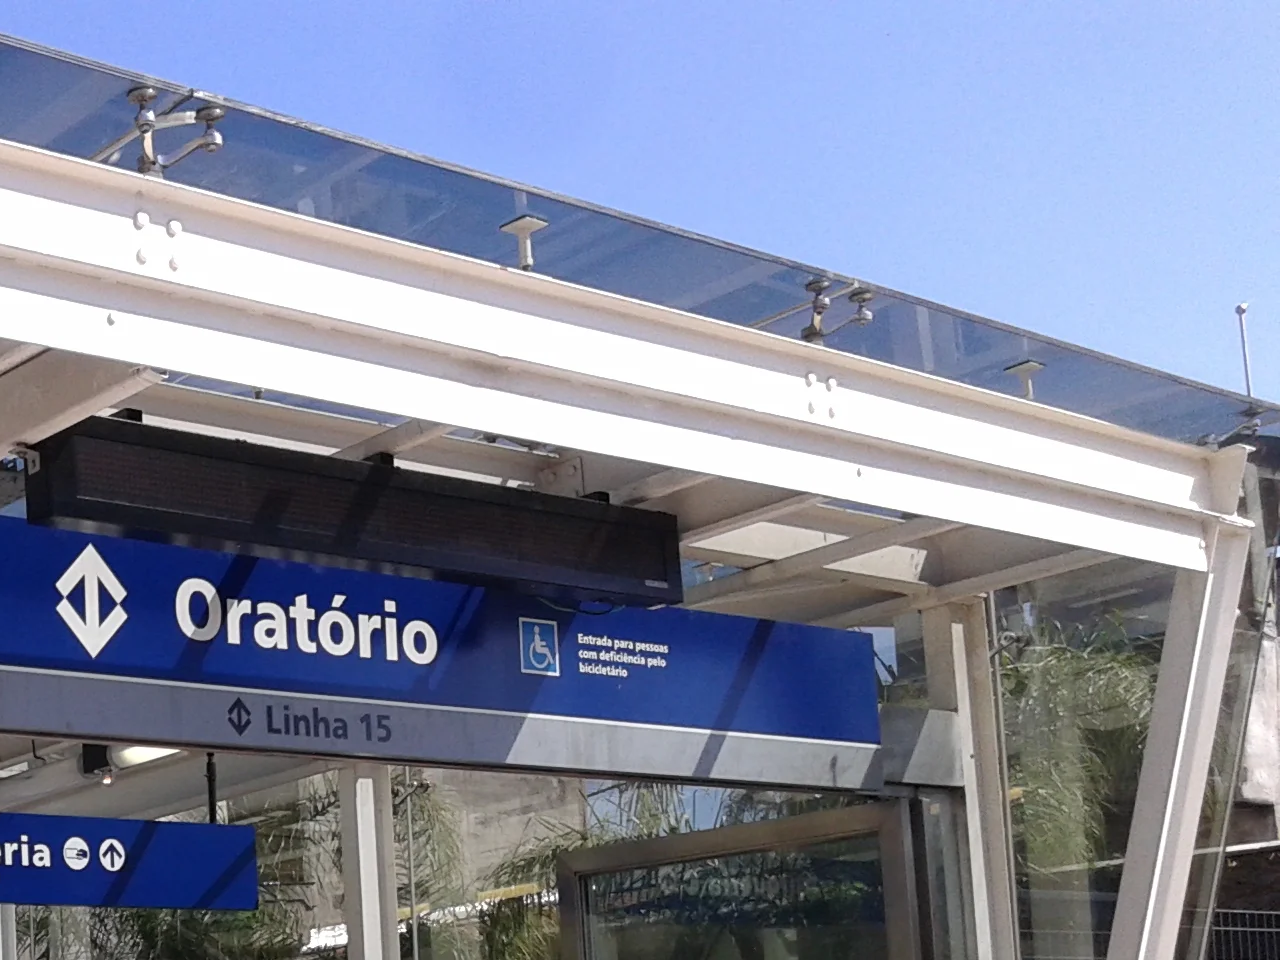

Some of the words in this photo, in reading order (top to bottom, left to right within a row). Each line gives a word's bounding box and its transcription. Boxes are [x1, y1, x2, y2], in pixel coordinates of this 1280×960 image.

[175, 577, 438, 666] Oratório
[578, 633, 612, 648] Entrada
[614, 639, 634, 651] para
[635, 642, 669, 654] pessoas
[578, 650, 597, 660] com
[599, 651, 645, 665] deficiência
[647, 656, 667, 668] pelo
[579, 662, 628, 678] bicicletário
[266, 705, 349, 741] Linha
[359, 712, 392, 742] 15
